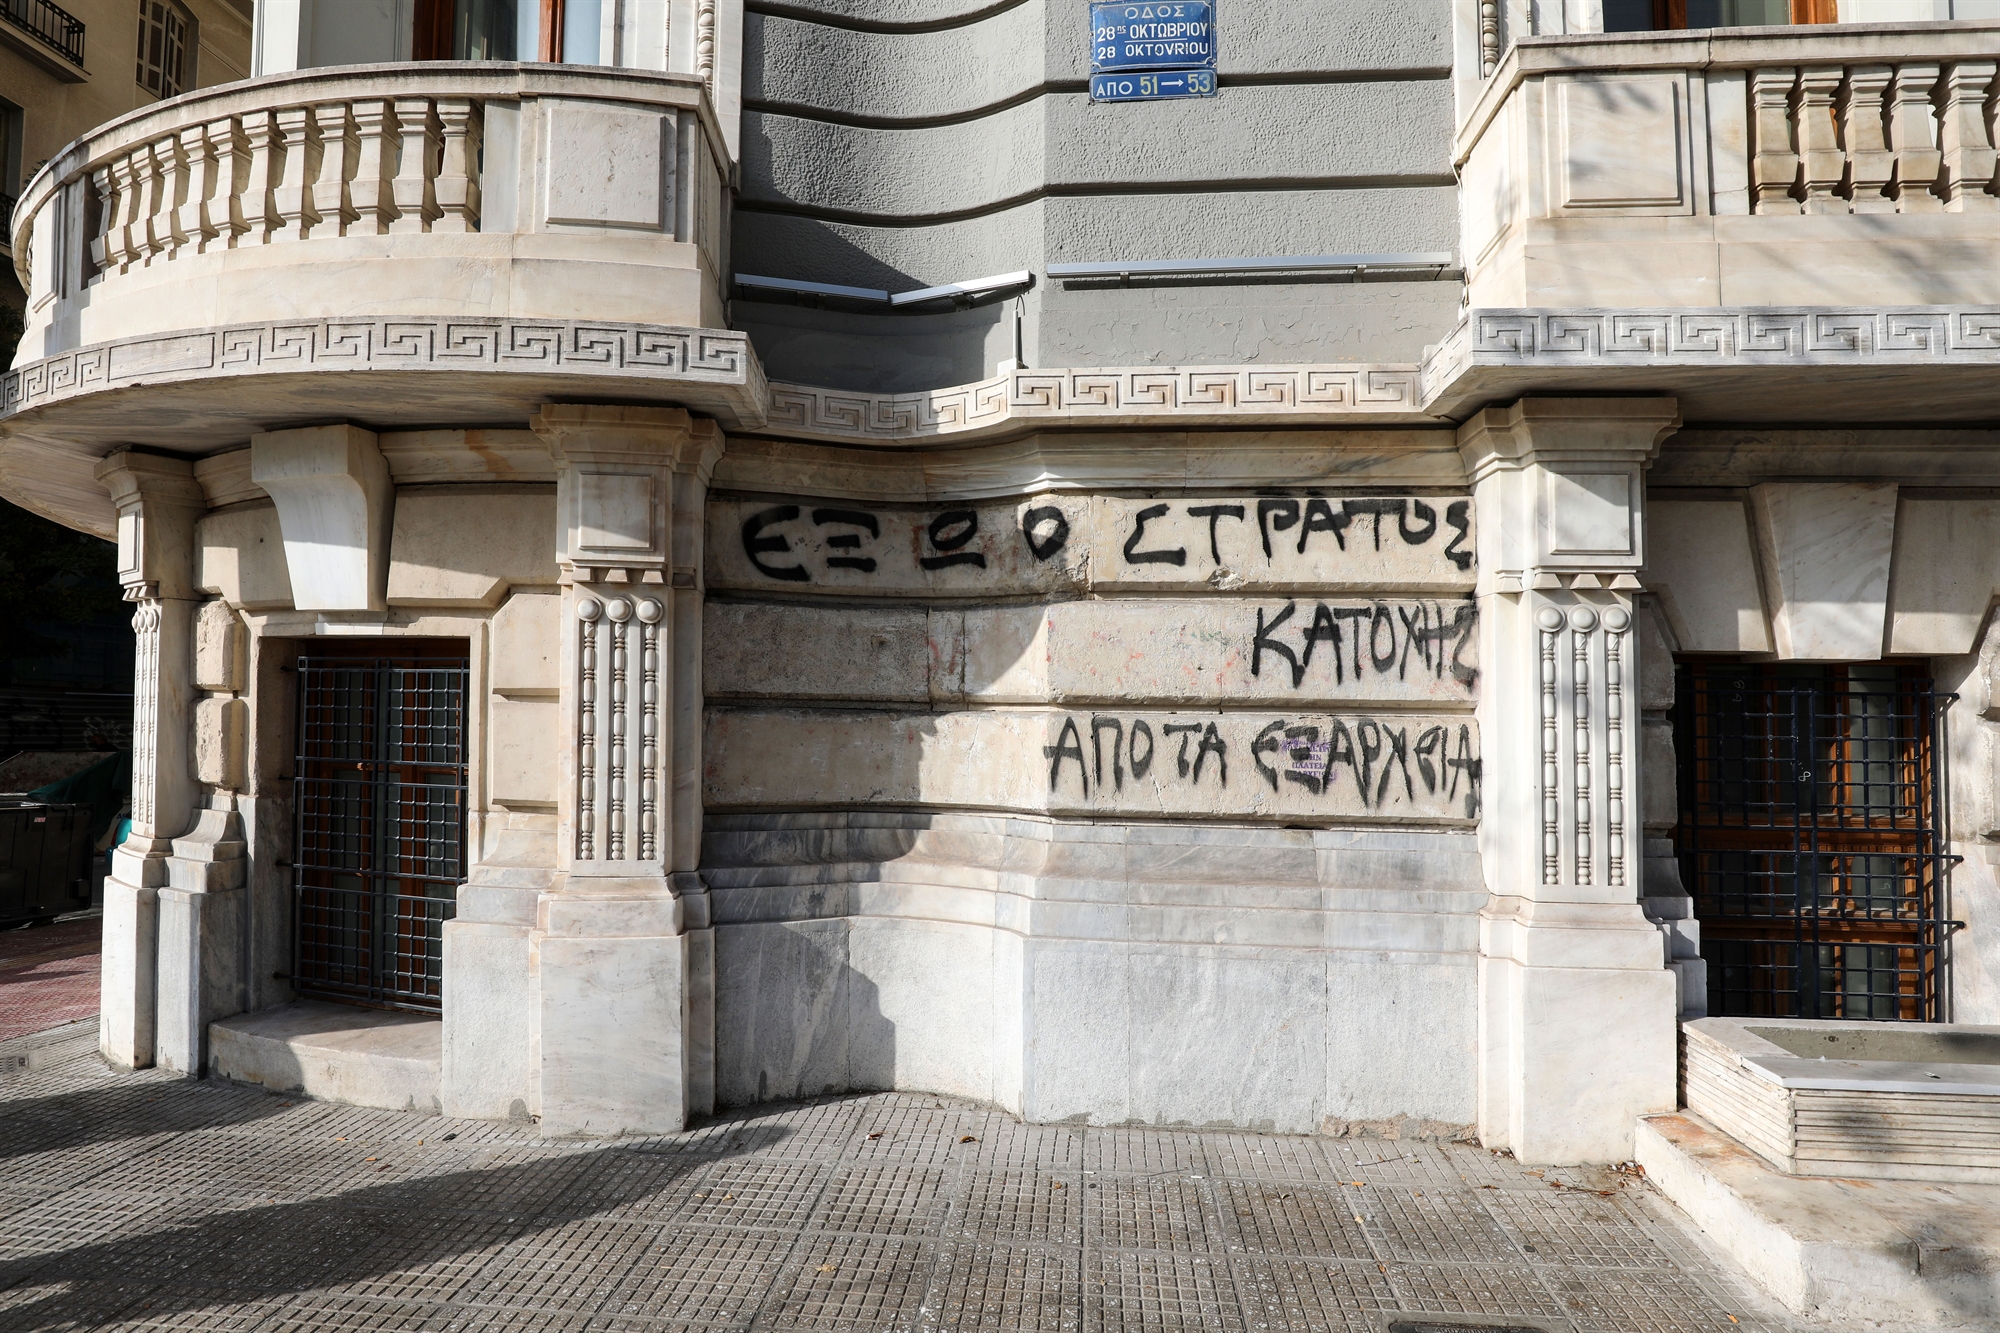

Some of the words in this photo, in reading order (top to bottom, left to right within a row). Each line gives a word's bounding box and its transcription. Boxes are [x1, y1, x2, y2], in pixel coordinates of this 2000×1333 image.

[1125, 5, 1185, 19] ΟΔΟΣ
[1130, 22, 1208, 39] ΟΚΤΩΒΡΙΟΥ
[1097, 46, 1116, 60] 28
[1125, 42, 1209, 57] OKTOVRIOU
[1096, 81, 1133, 97] ΑΠΟ
[1140, 75, 1158, 95] 51
[1188, 73, 1211, 93] 53
[1043, 716, 1154, 798] ΑΠΟ
[1163, 721, 1228, 787] ΤΑ
